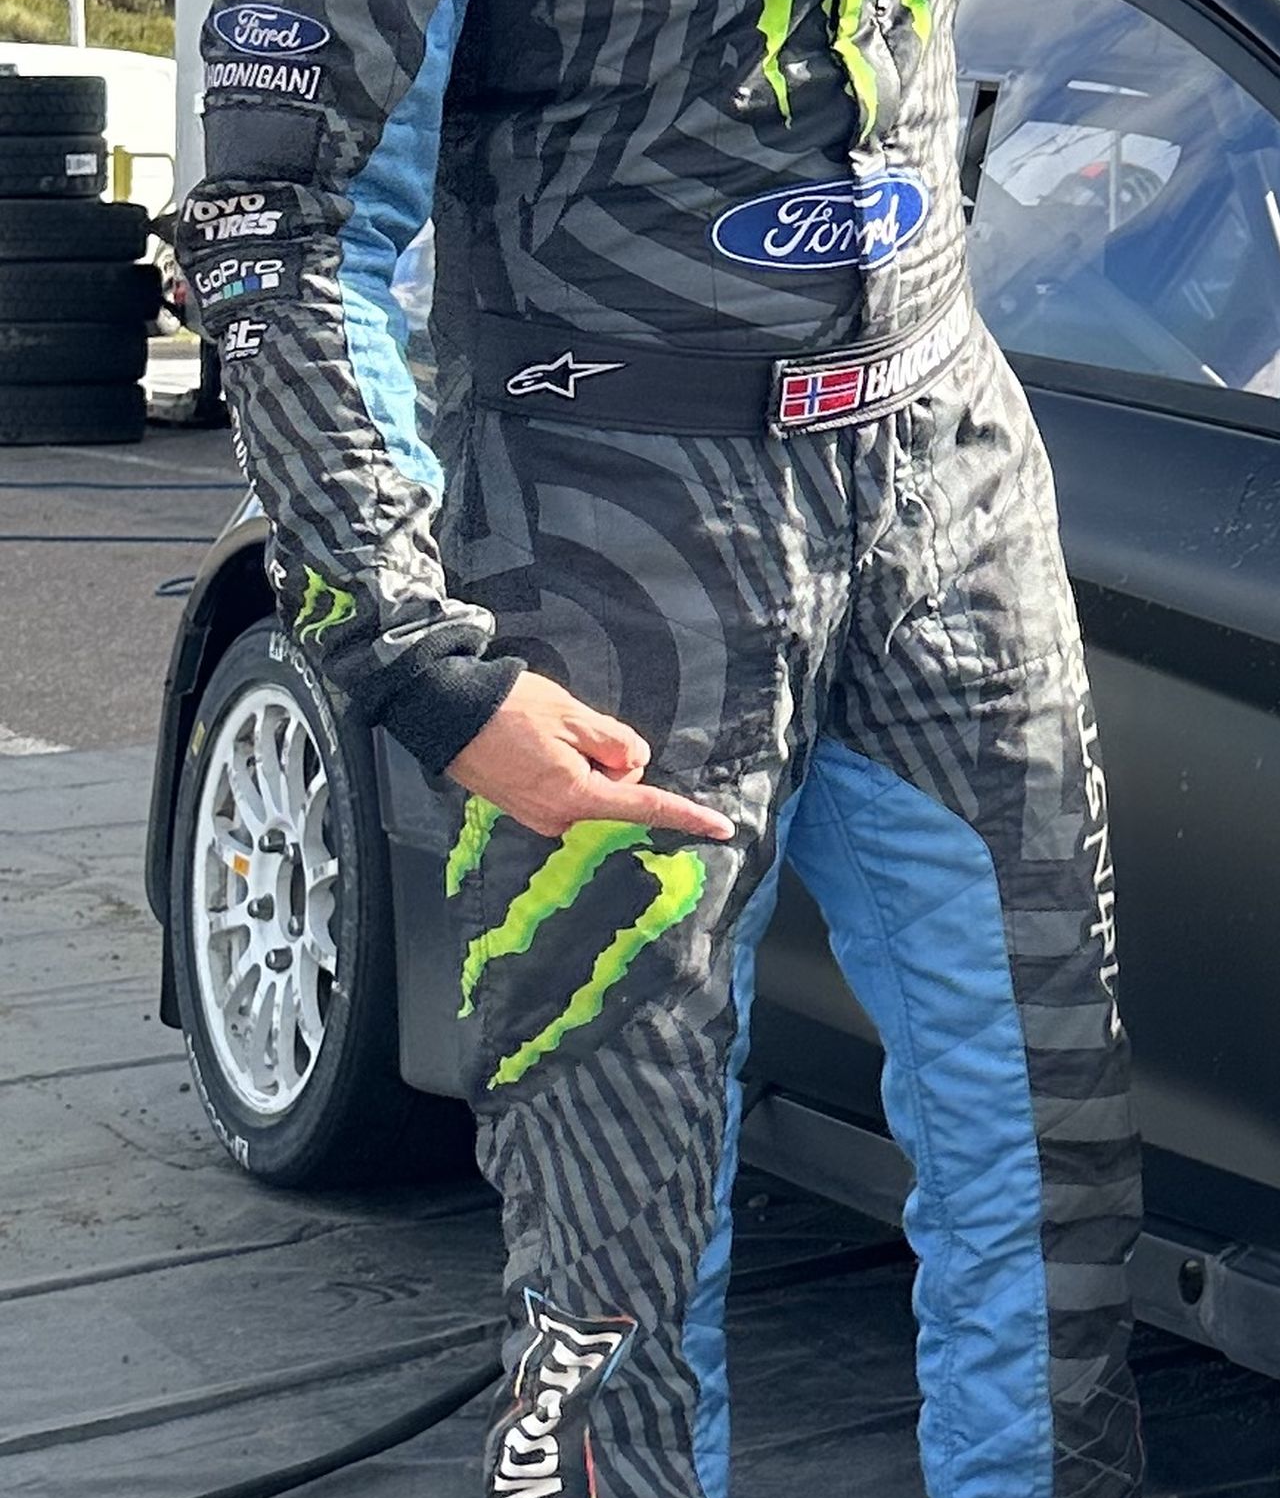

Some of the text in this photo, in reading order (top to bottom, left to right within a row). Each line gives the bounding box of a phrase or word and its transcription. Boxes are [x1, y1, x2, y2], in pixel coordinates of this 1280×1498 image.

[234, 9, 301, 49] Ford
[195, 210, 283, 241] TIRES
[764, 190, 900, 257] Ford
[195, 259, 284, 294] GoPro
